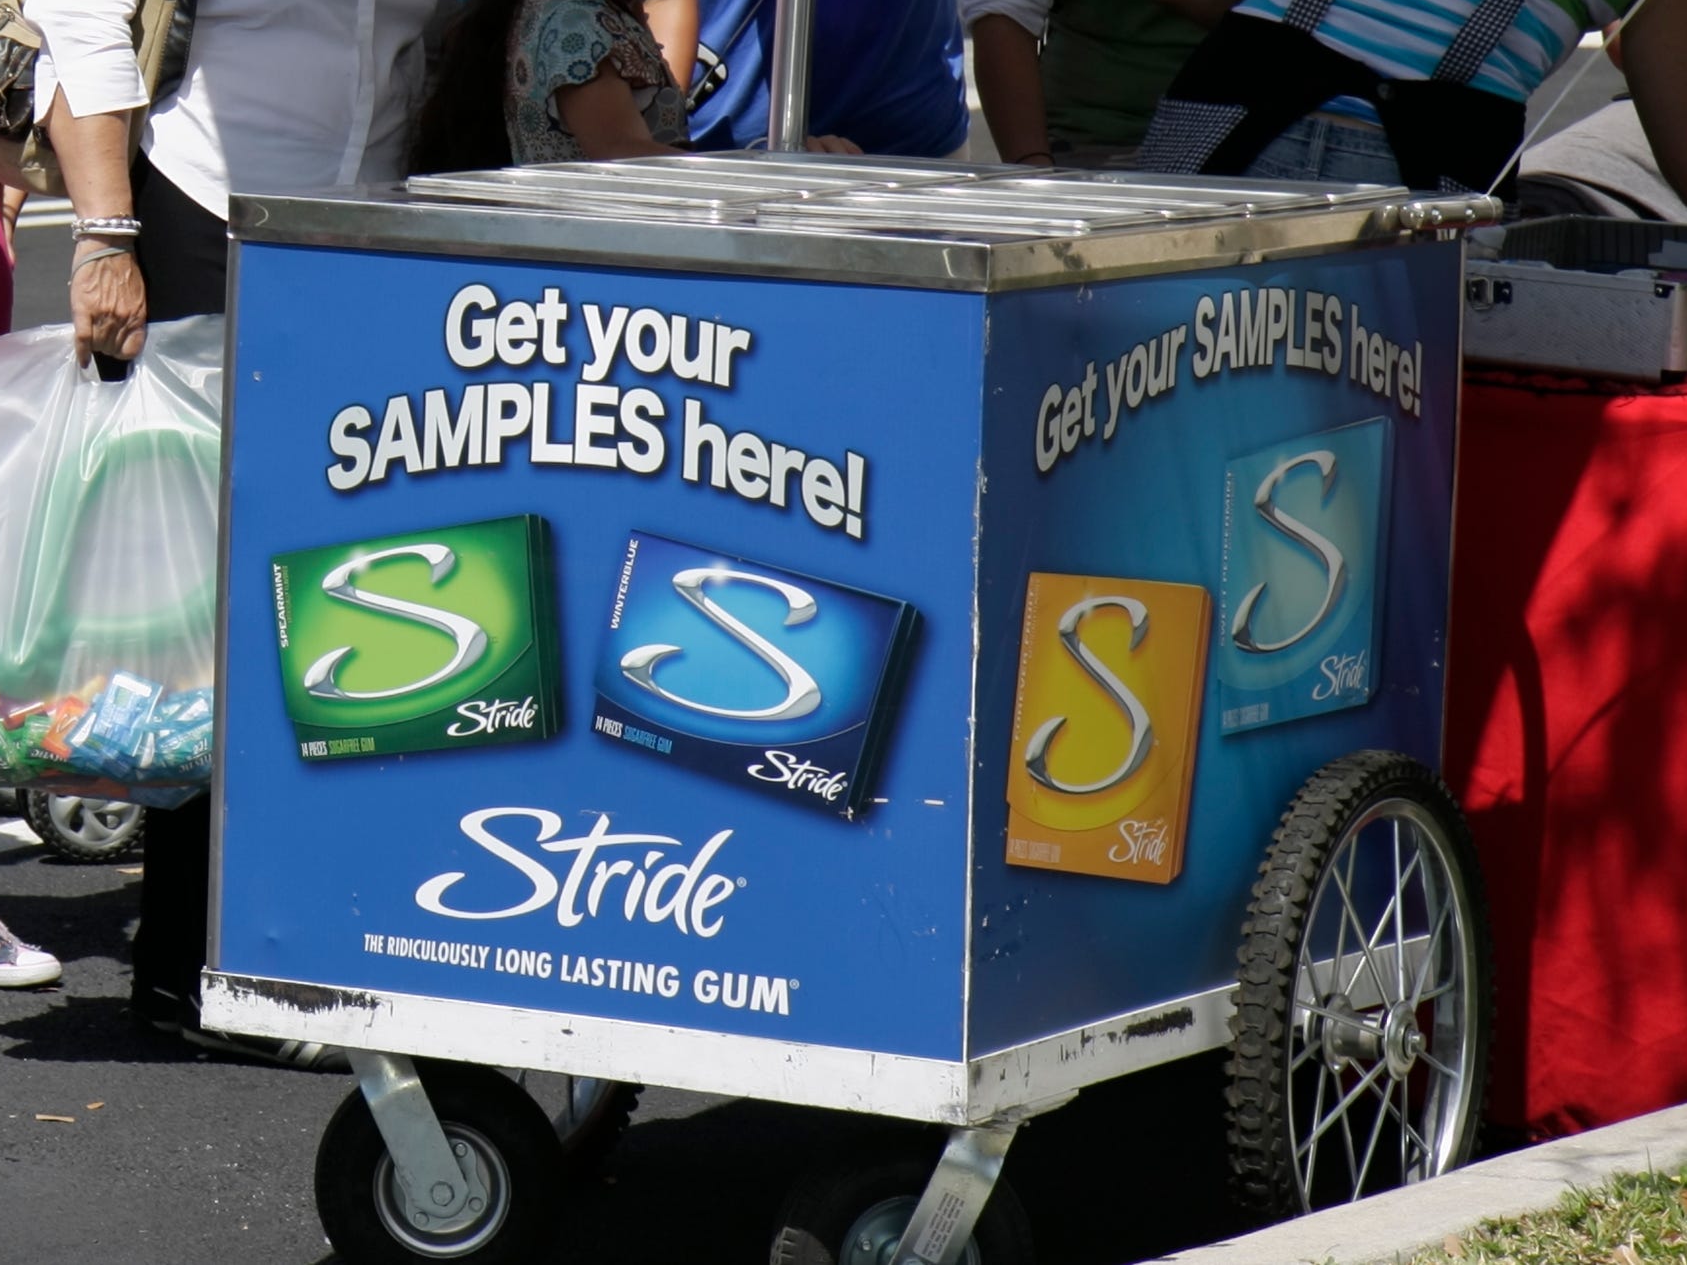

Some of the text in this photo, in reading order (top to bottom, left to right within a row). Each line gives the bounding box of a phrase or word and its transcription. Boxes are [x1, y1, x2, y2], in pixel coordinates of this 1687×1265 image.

[445, 284, 751, 388] Get your
[1035, 287, 1424, 473] Get your SAMPLES here!
[326, 381, 866, 539] SAMPLES here!
[273, 563, 290, 649] SPEARMINT
[609, 539, 639, 630] WINTERBLUE
[446, 699, 535, 738] Stride
[1312, 653, 1366, 701] Stride
[747, 749, 845, 803] Stride
[415, 807, 734, 939] Stride
[1108, 819, 1168, 866] Stride
[363, 933, 790, 1016] THE RIDICULOUSLY LONG LASTING GUM
